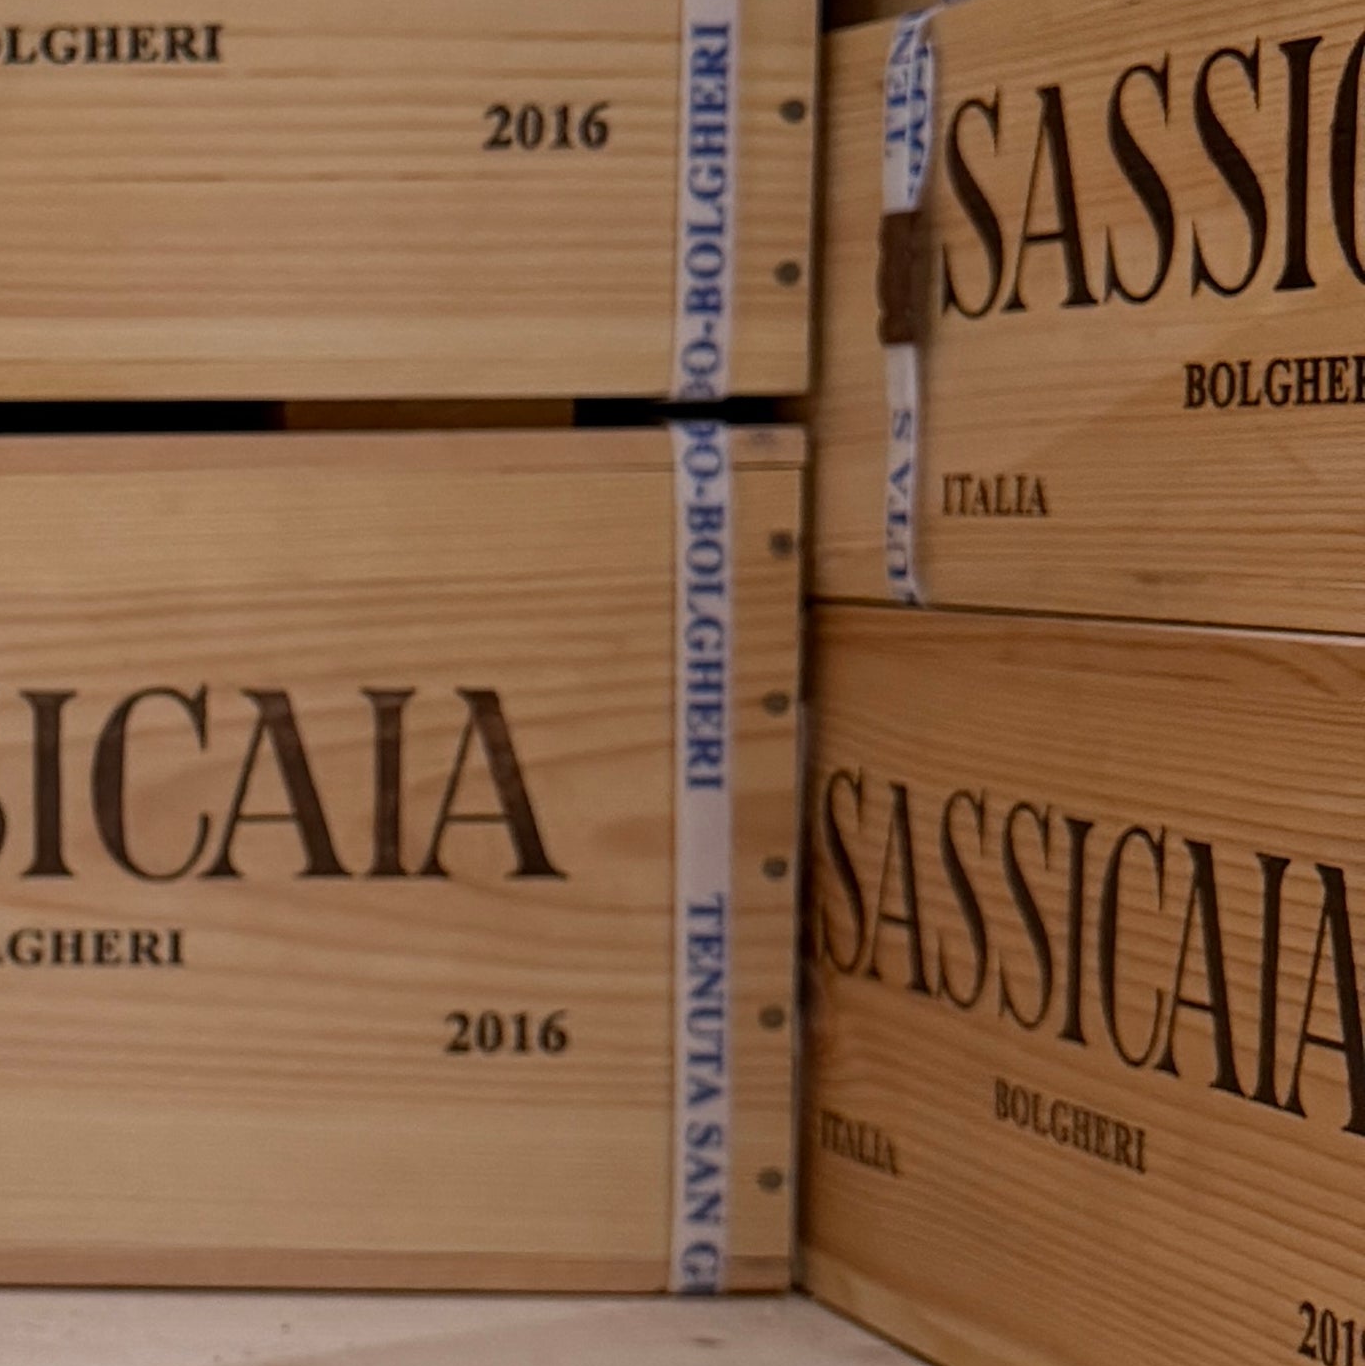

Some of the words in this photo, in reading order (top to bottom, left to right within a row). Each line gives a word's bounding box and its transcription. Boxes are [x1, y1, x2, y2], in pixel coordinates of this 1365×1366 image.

[483, 102, 611, 150] 2016
[941, 471, 1049, 518] ITALIA
[815, 765, 1365, 1138] SASSICAIA
[444, 1010, 568, 1054] 2016
[686, 892, 726, 1108] TENUTA
[820, 1108, 901, 1177] ITALIA
[994, 1076, 1148, 1175] BOLGHERI
[682, 1121, 724, 1227] SAN
